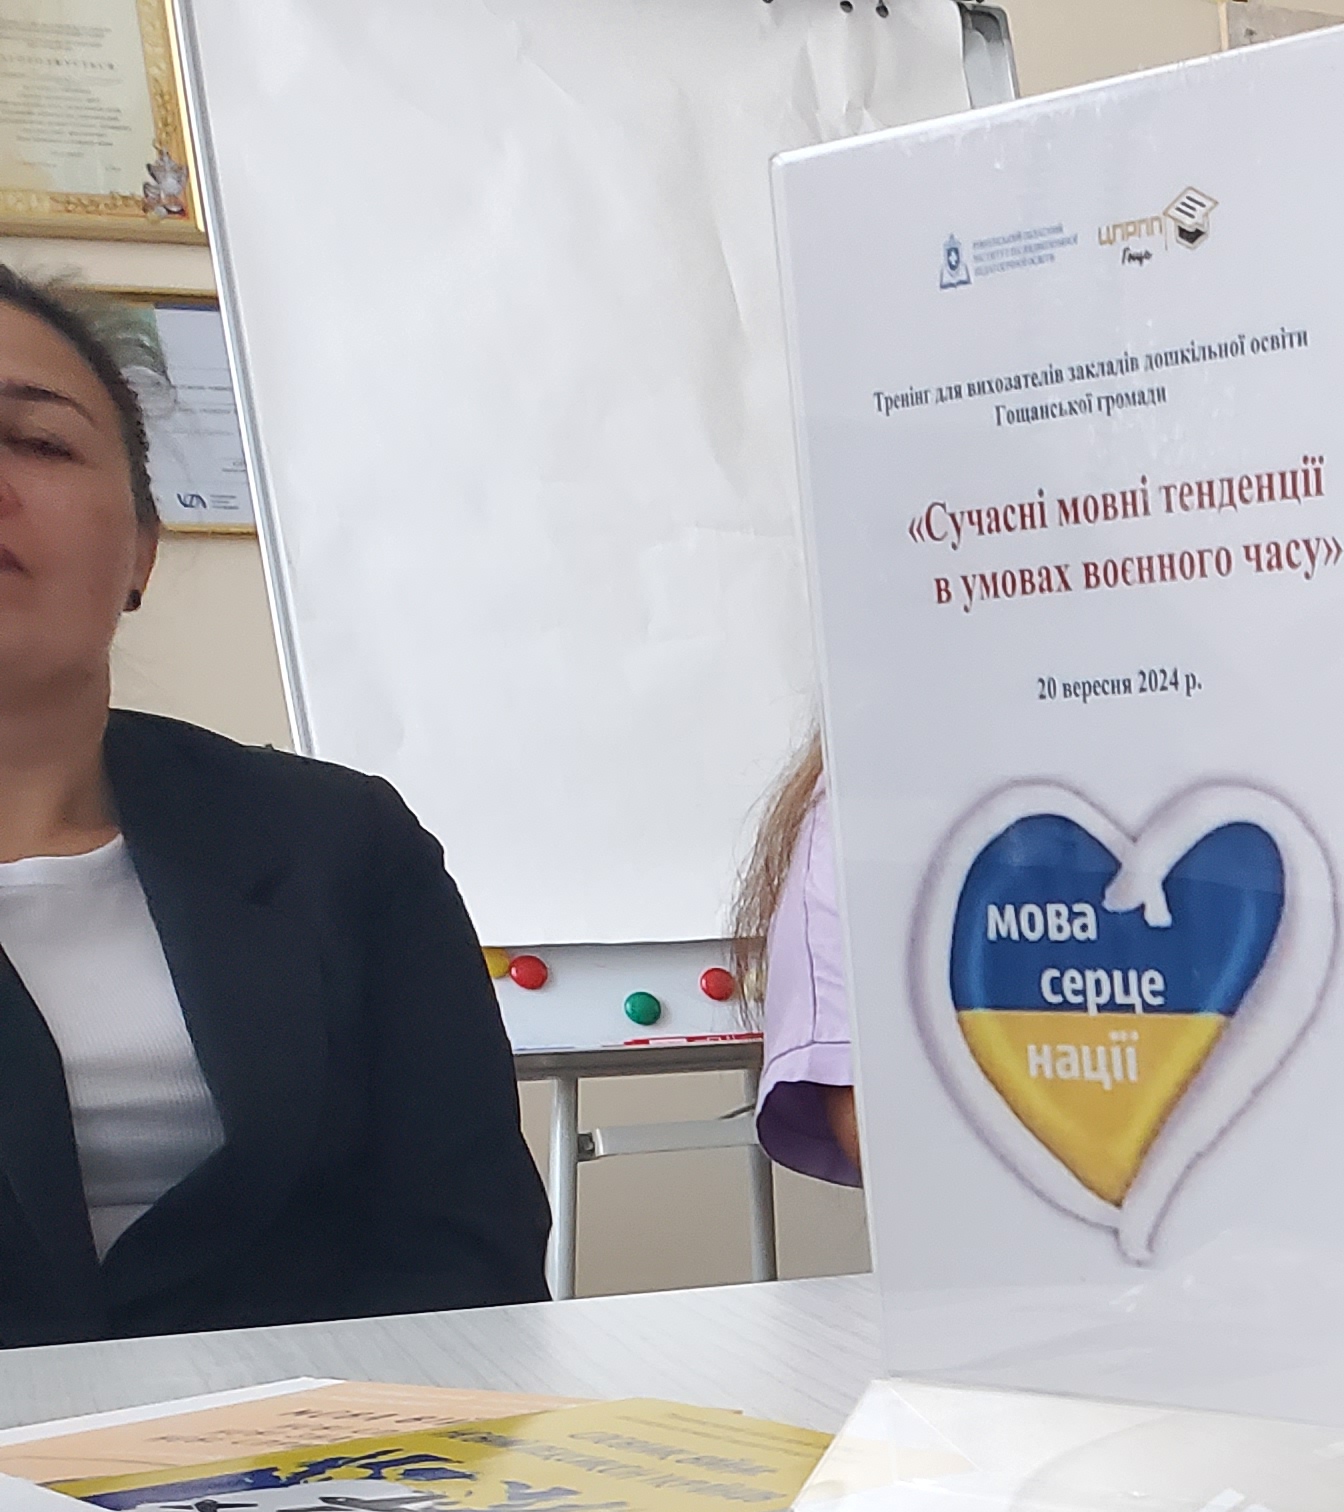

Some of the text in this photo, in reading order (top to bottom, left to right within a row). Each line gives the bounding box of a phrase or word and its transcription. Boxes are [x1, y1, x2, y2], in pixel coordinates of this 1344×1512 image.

[873, 326, 1309, 418] Тренінг для вихователів закладів дошкільної освіти
[994, 384, 1168, 427] Гощанської громади
[908, 455, 1325, 550] «Сучасні мовні тенденції
[934, 534, 1344, 613] в умовах воєнного часу»
[1037, 667, 1203, 704] 20 вересня 2024 р.
[986, 902, 1098, 942] мова
[1040, 967, 1166, 1016] серце
[1026, 1029, 1140, 1091] нації
